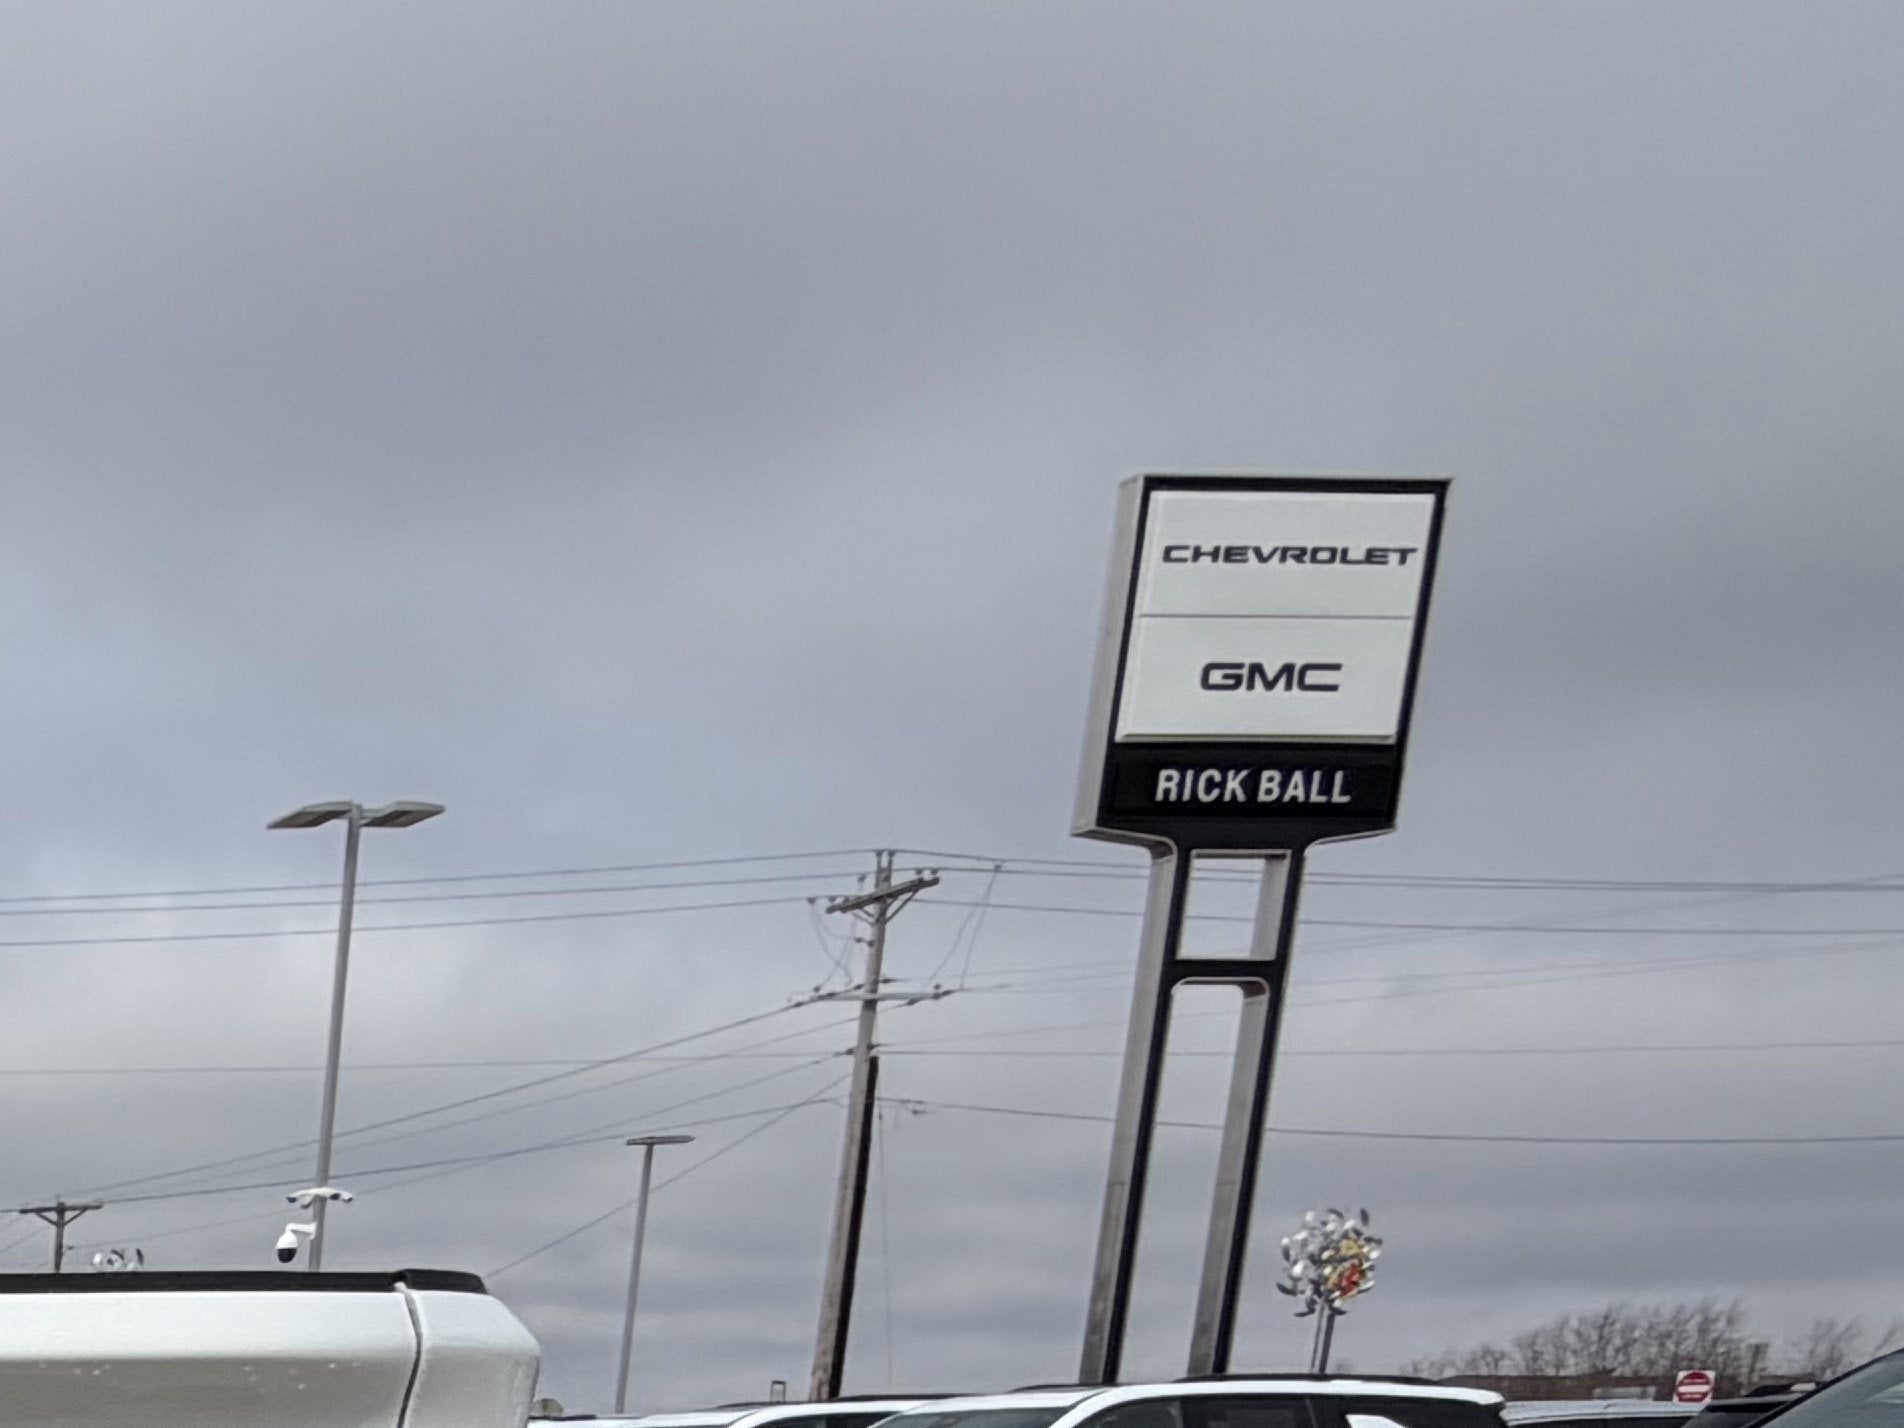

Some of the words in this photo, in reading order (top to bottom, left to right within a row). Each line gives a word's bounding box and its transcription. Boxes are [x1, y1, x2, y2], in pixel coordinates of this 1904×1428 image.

[1162, 544, 1419, 566] CHEVROLET
[1200, 662, 1343, 692] GMC
[1155, 769, 1250, 802] RICK
[1257, 770, 1352, 803] BALL
